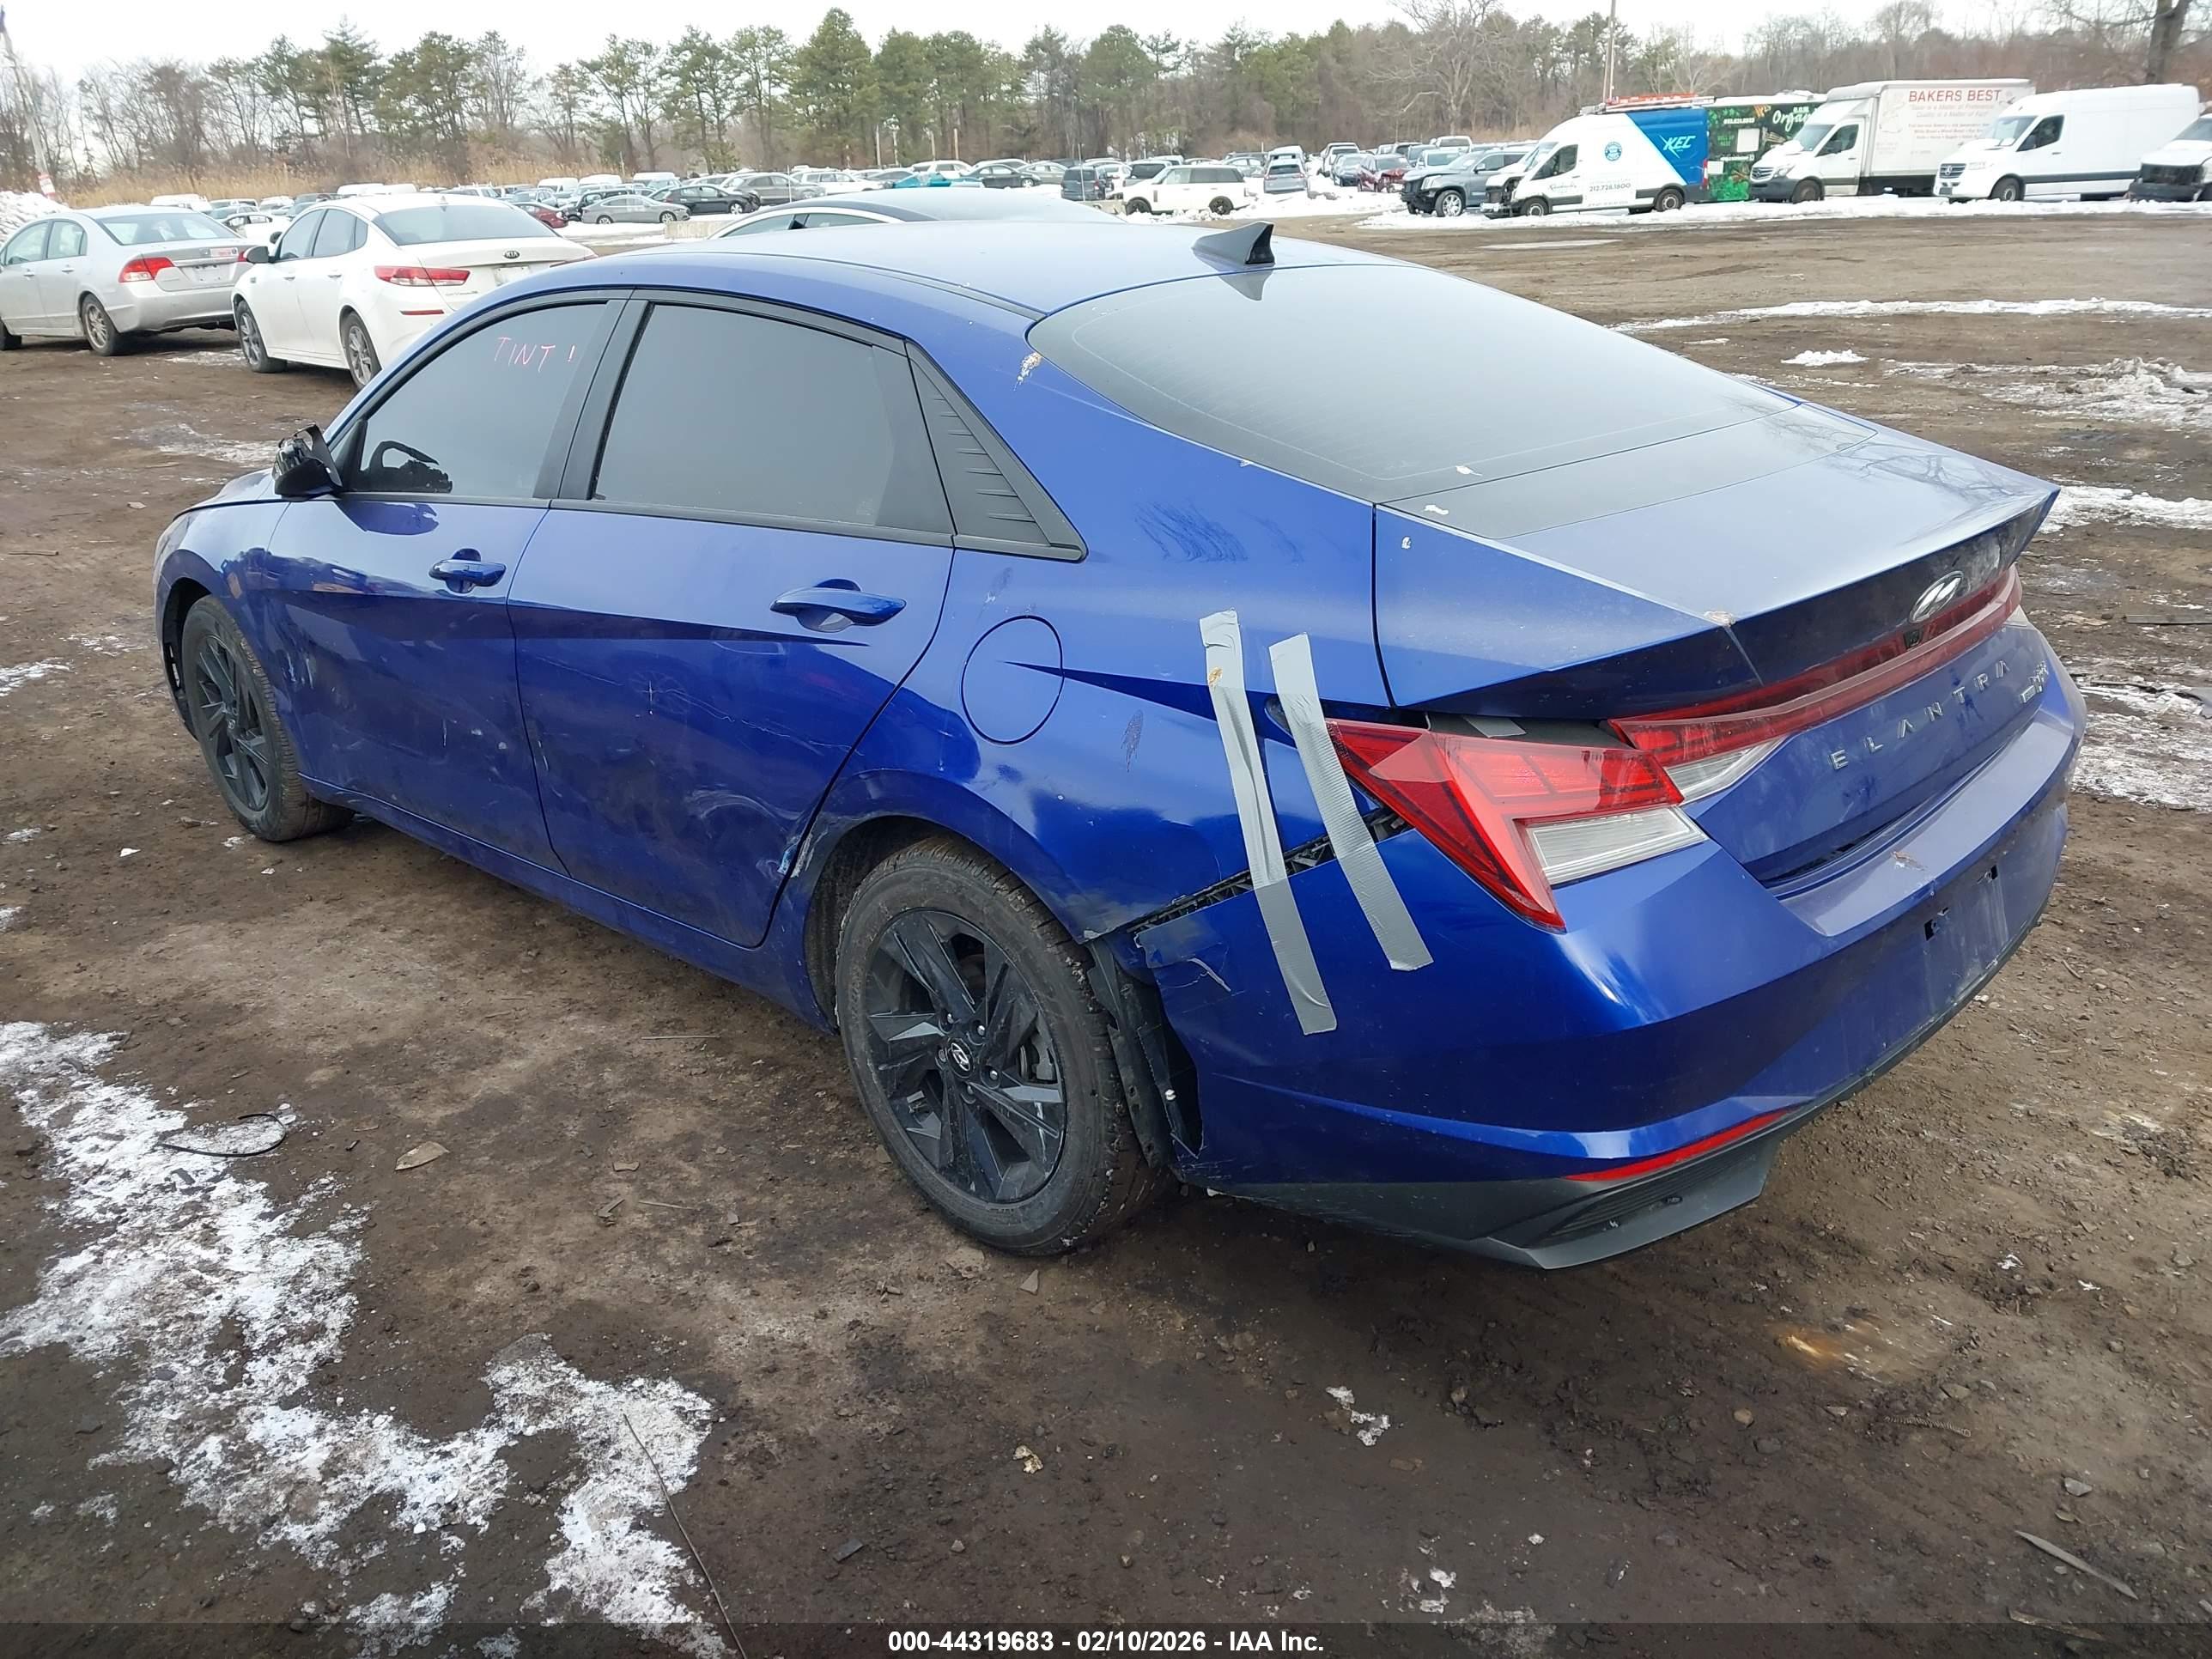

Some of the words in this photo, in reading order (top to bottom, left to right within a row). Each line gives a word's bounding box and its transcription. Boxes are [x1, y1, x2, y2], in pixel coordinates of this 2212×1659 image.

[1909, 89, 1962, 102] BAKERS
[1967, 89, 2002, 101] BEST
[1659, 135, 1697, 155] KEC
[494, 337, 556, 373] TINT
[1828, 659, 2011, 771] ELANTRA
